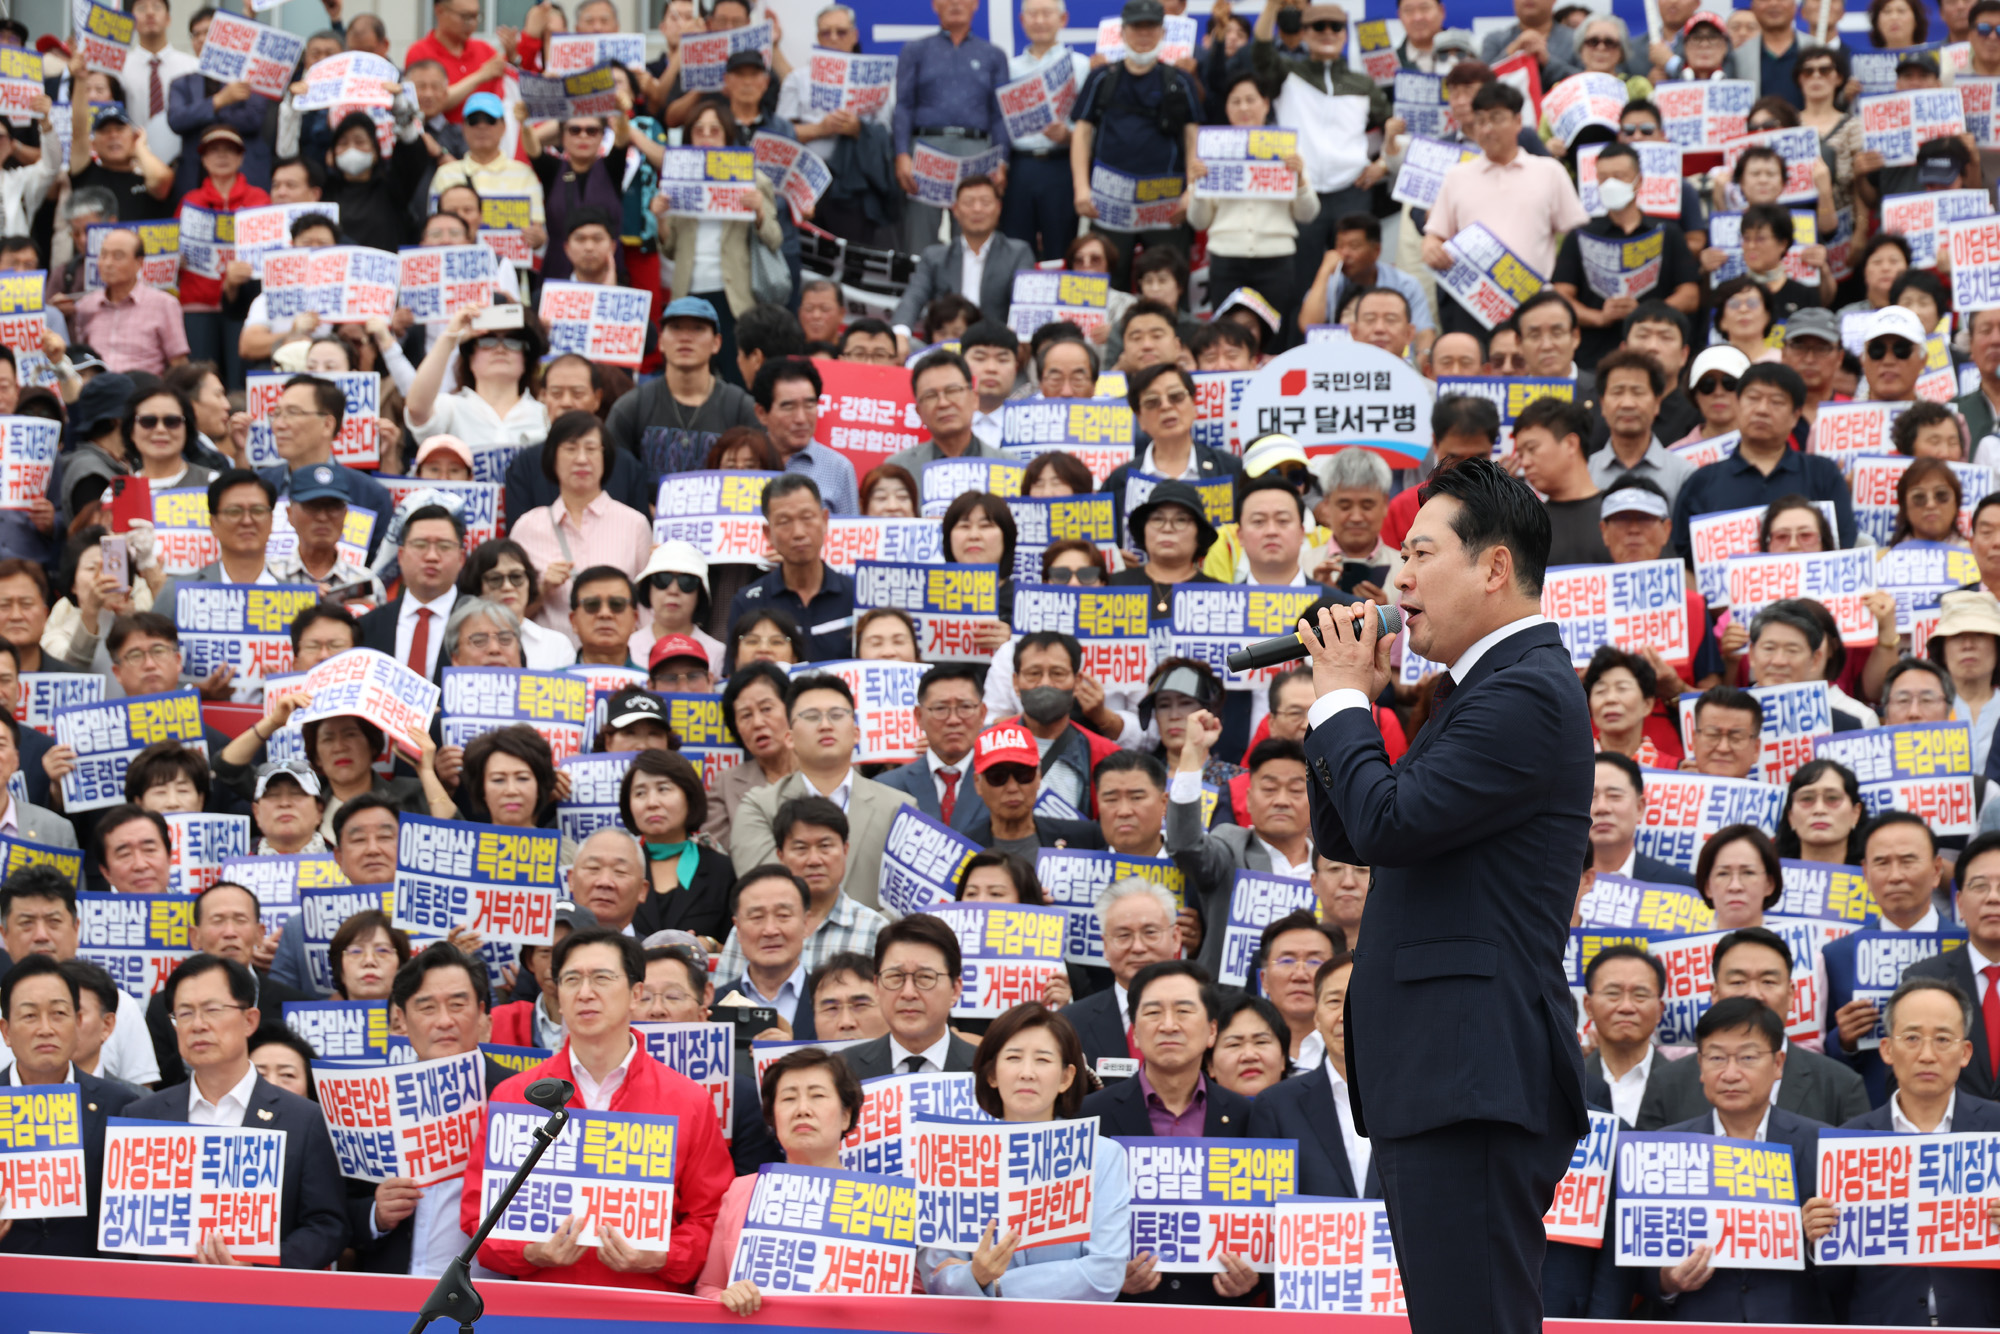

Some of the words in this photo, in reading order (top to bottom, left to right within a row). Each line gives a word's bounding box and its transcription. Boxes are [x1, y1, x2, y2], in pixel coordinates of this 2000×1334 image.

[1312, 371, 1391, 391] 국민의힘
[1068, 406, 1132, 442] 특검악법
[1258, 407, 1307, 433] 대구
[1314, 406, 1415, 432] 달서구병
[1818, 409, 1883, 450] 야당탄압
[719, 522, 770, 557] 거부하
[1050, 501, 1113, 540] 특검악법
[1695, 520, 1761, 562] 야당탄압
[856, 568, 925, 610] 야당말살
[928, 572, 997, 612] 특검악법
[1612, 570, 1681, 611] 독재정치
[1731, 563, 1800, 603] 야당탄압
[1806, 556, 1874, 593] 독재정치
[178, 588, 245, 633] 야당말살
[1014, 590, 1076, 635] 야당말살
[1078, 594, 1148, 637] 특검악법
[1174, 592, 1245, 633] 야당말살
[1614, 610, 1684, 652] 규탄한다
[248, 642, 292, 678] 거부하
[1082, 645, 1146, 683] 거부하라
[373, 657, 435, 712] 독재정치
[444, 675, 515, 714] 야당말살
[518, 676, 586, 721] 특검악법
[1761, 685, 1828, 731] 독재정치
[55, 708, 127, 755] 야당말살
[128, 696, 201, 743] 특검악법
[979, 728, 1028, 751] MAGA
[1894, 729, 1969, 777] 특검악법
[1708, 785, 1785, 829] 독재정치
[1900, 782, 1972, 826] 거부하라
[400, 821, 475, 878] 야당말살
[477, 832, 558, 884] 특검악법
[887, 812, 963, 885] 야당말살
[1037, 856, 1113, 904] 야당말살
[398, 878, 468, 927] 대통령은
[474, 890, 552, 937] 거부하라
[986, 910, 1065, 957] 특검악법
[318, 1076, 392, 1128] 야당탄압
[393, 1053, 482, 1122] 독재정치
[910, 1080, 995, 1121] 독재정
[107, 1136, 197, 1191] 야당탄압
[201, 1135, 281, 1189] 독재정치
[333, 1130, 399, 1178] 정치보복
[583, 1120, 674, 1178] 특검악법
[918, 1133, 1001, 1188] 야당탄압
[1008, 1121, 1094, 1185] 독재정치
[1620, 1141, 1710, 1195] 야당말살
[1712, 1143, 1796, 1202] 특검악법
[1821, 1146, 1912, 1204] 야당탄압
[1919, 1137, 2000, 1196] 독재정치
[1208, 1148, 1294, 1201] 특검악법
[104, 1194, 191, 1247] 정치보복
[198, 1192, 277, 1246] 규탄한다
[580, 1185, 668, 1242] 거부하라
[747, 1172, 830, 1231] 야당말살
[829, 1179, 916, 1243] 특검악법
[919, 1191, 999, 1245] 정치보복
[1008, 1175, 1091, 1237] 규탄한다
[1129, 1211, 1200, 1263] 통령은
[1207, 1213, 1275, 1263] 거부하
[1279, 1211, 1366, 1266] 야당탄압
[1621, 1207, 1708, 1258] 대통령은
[1715, 1208, 1799, 1261] 거부하라
[1821, 1203, 1909, 1262] 정치보복
[734, 1235, 816, 1293] 대통령은
[819, 1246, 910, 1295] 거부하라
